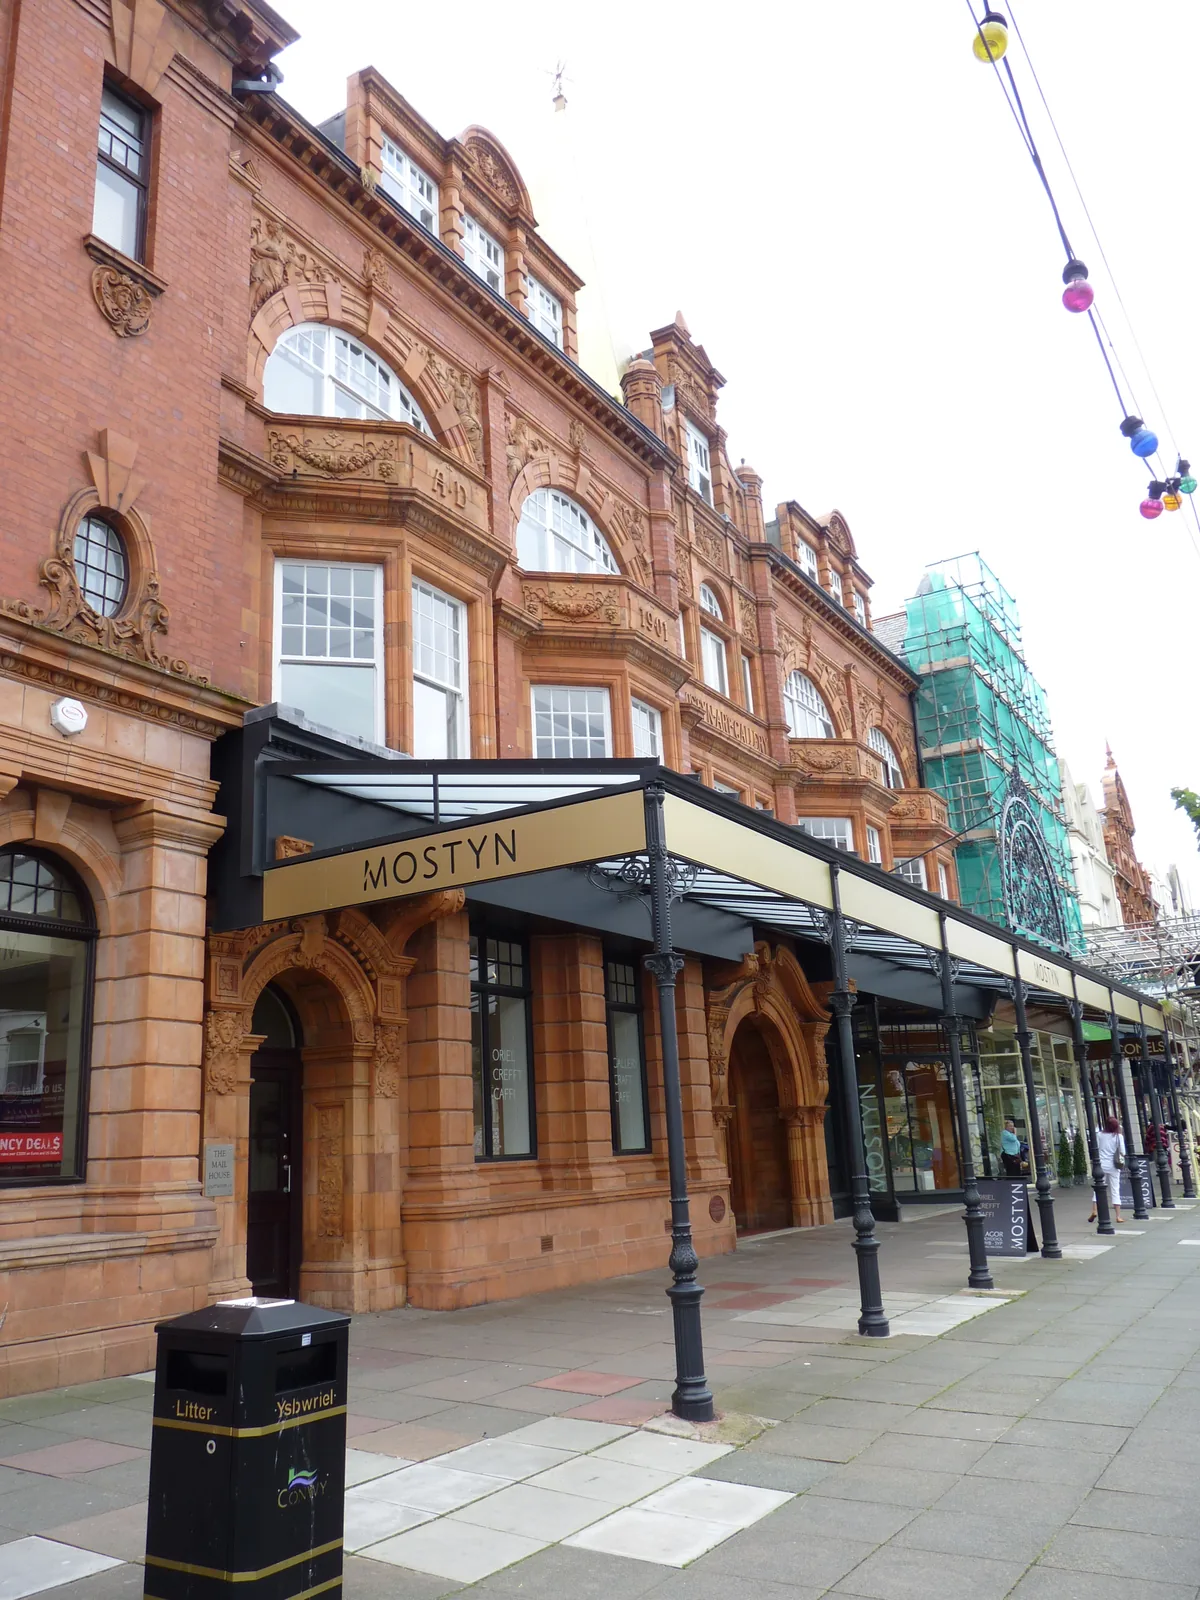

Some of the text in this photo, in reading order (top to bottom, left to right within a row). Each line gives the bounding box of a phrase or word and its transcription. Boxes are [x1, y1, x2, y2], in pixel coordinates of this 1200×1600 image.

[364, 829, 516, 891] MOSTYN
[1033, 960, 1060, 987] MOSTYN
[213, 1150, 227, 1158] THE
[208, 1171, 231, 1180] HOUSE
[1011, 1183, 1024, 1250] MOSTYN
[176, 1400, 213, 1421] Litter
[277, 1388, 334, 1419] Ysbwriel
